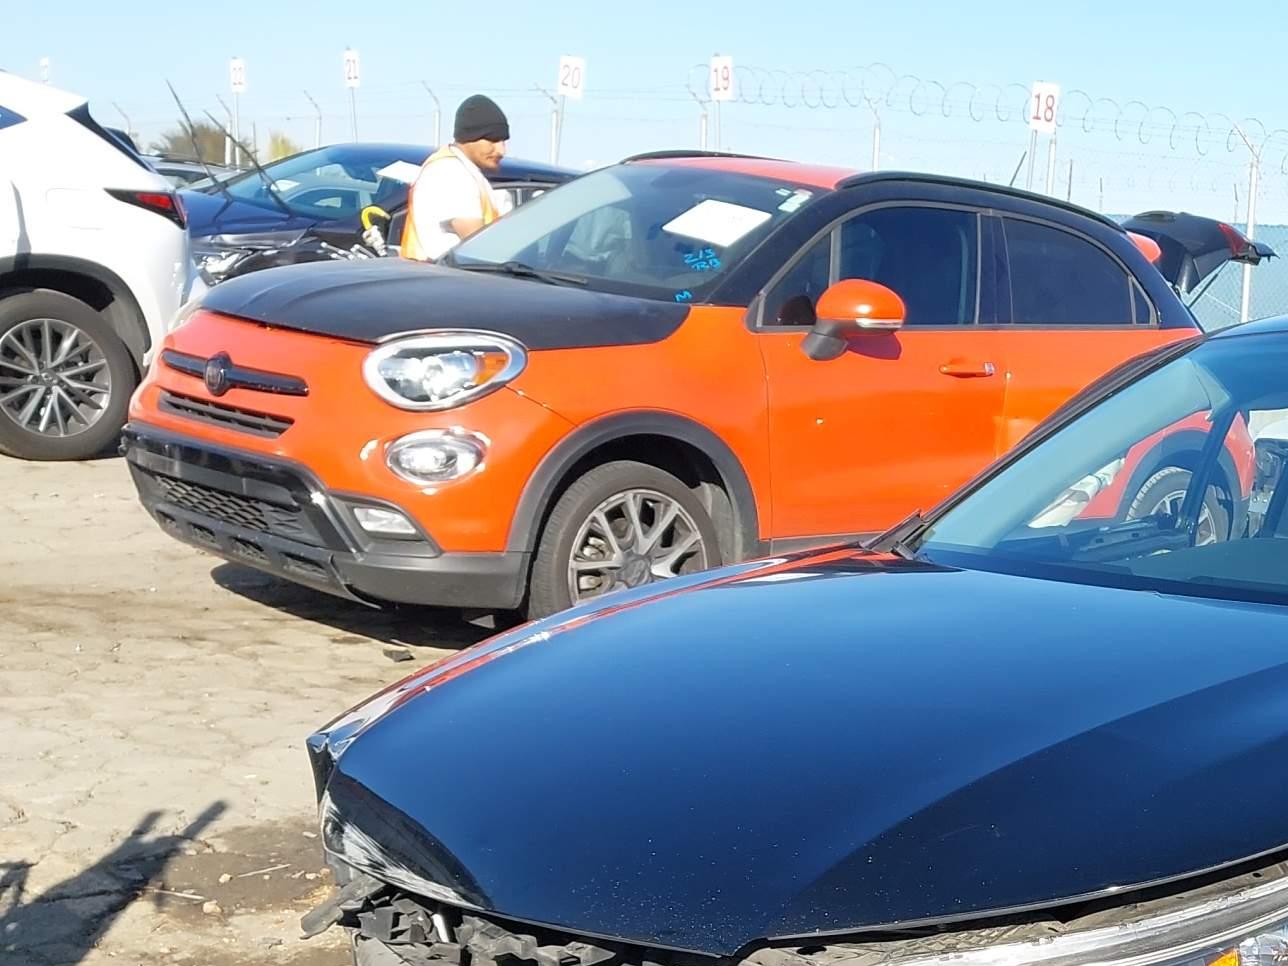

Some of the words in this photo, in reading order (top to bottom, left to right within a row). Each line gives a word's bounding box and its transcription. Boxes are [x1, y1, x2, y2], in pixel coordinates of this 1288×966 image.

[561, 64, 581, 89] 20
[713, 65, 731, 92] 19
[1031, 92, 1056, 122] 18
